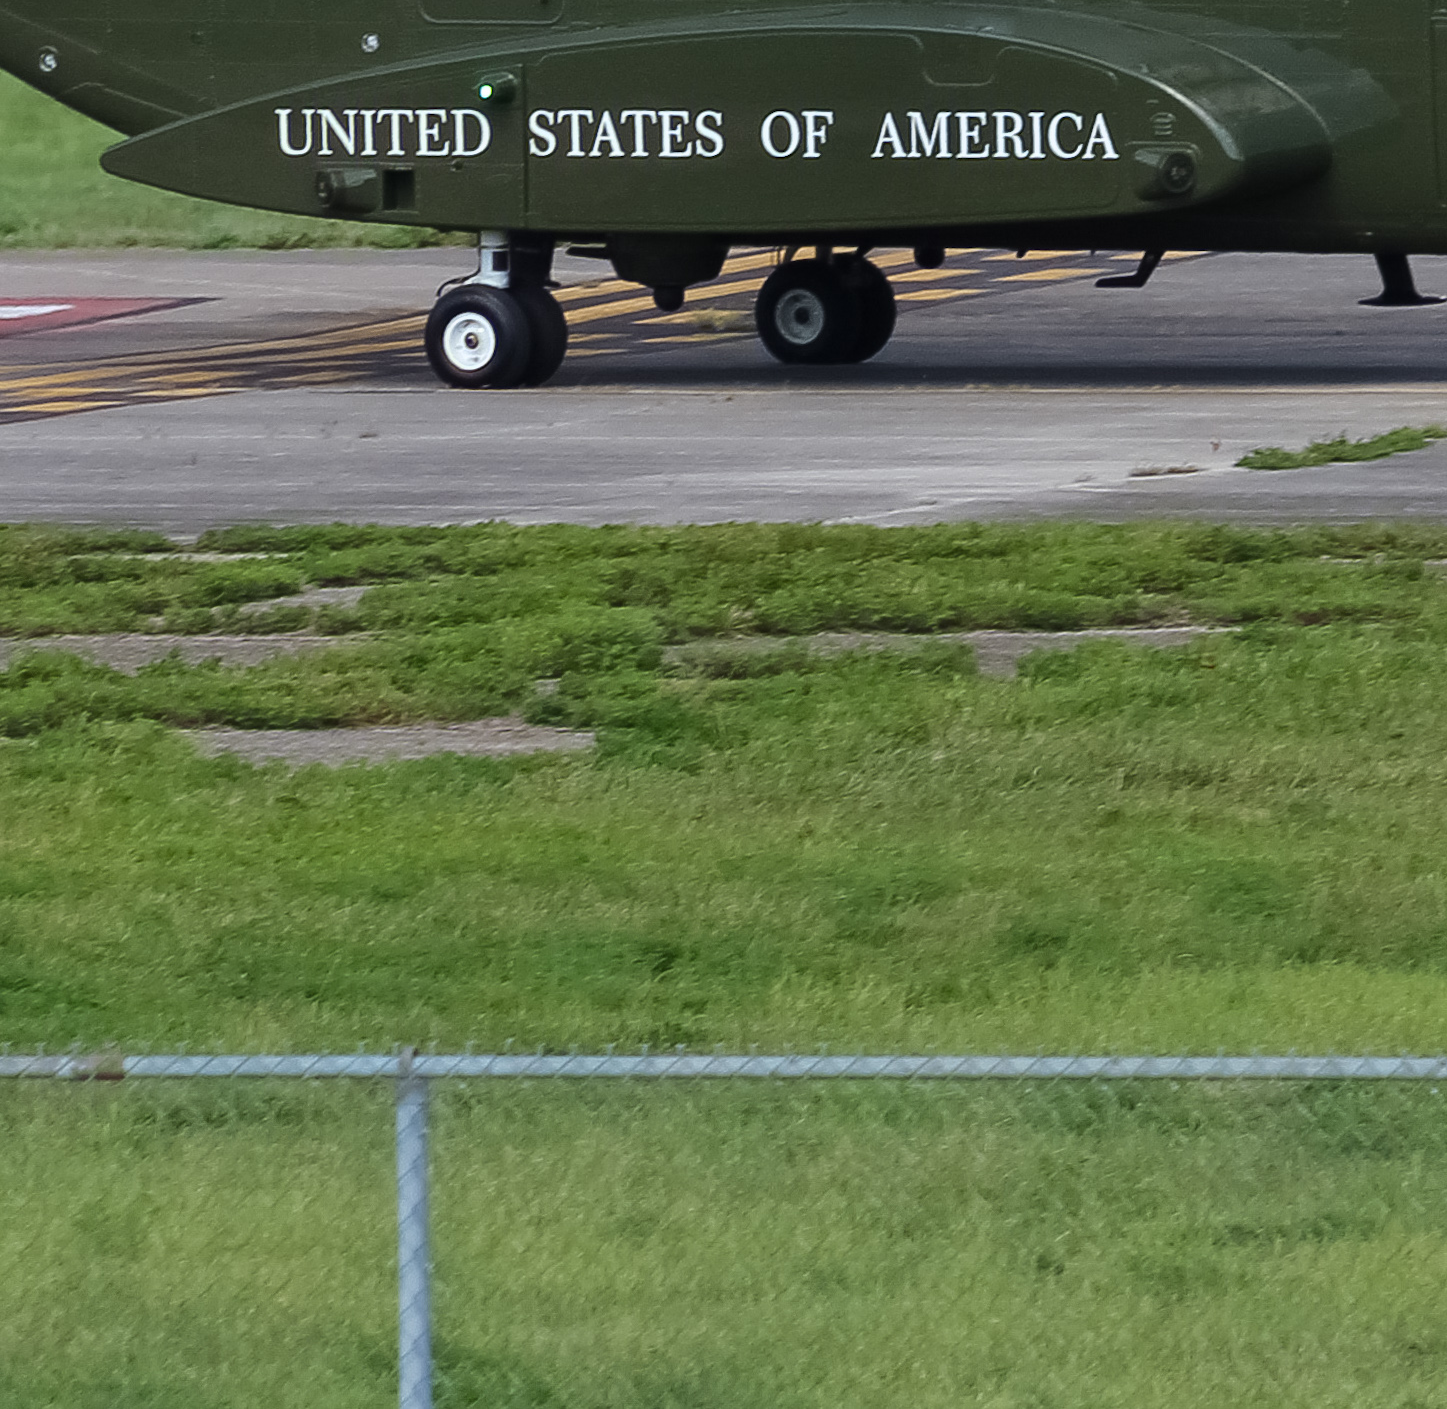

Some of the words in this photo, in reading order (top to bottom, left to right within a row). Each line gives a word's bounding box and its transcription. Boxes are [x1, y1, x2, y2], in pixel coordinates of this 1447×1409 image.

[274, 107, 492, 158] UNITED
[527, 109, 725, 158] STATES
[759, 110, 835, 158] OF
[870, 110, 1121, 160] AMERICA
